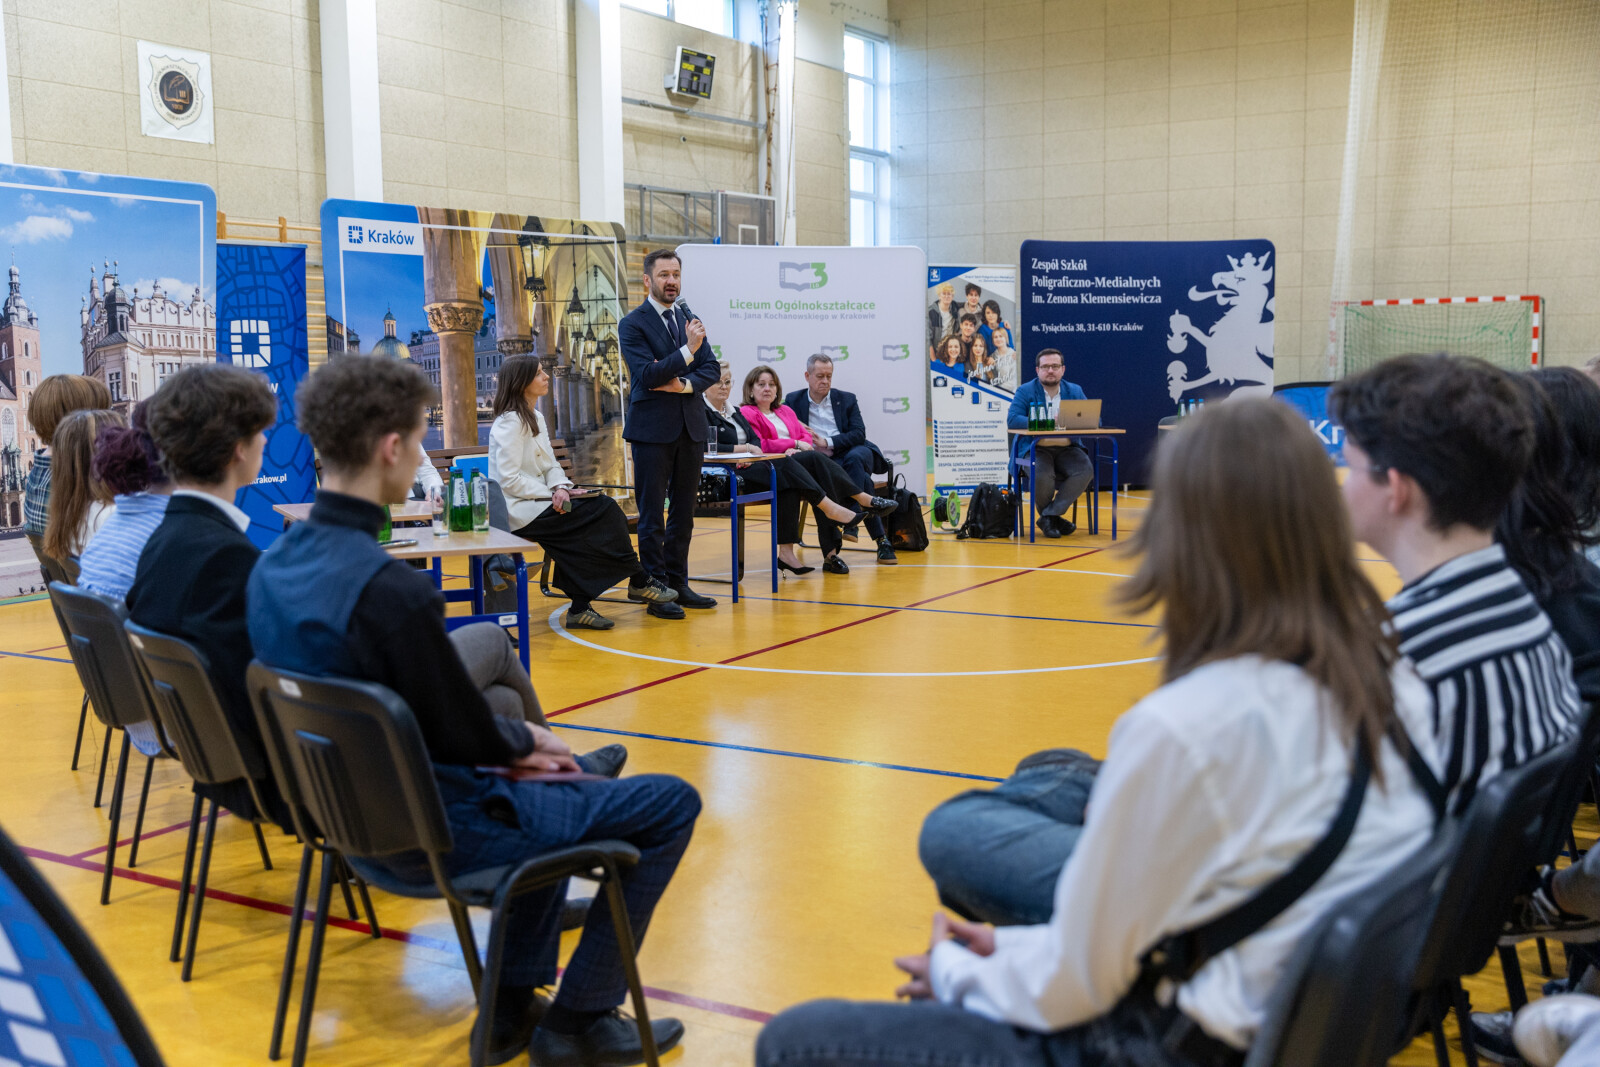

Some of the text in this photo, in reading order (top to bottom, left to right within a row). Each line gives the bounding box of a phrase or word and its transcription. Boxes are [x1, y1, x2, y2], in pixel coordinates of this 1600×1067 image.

[368, 229, 415, 245] Kraków
[1031, 258, 1088, 273] Zespół Szkół
[1032, 275, 1161, 290] Poligraficzno-Medialnych
[1032, 292, 1162, 304] im. Zenona Klemensiewicza
[729, 299, 876, 313] Liceum Ogólnokształcące
[744, 312, 762, 320] Jana
[764, 312, 830, 321] Kochanowskiego
[840, 312, 876, 320] Krakowie
[1041, 323, 1074, 334] Tysiąclecia
[1075, 323, 1086, 333] 38,
[1087, 323, 1111, 332] 31-610
[1112, 322, 1144, 332] Kraków
